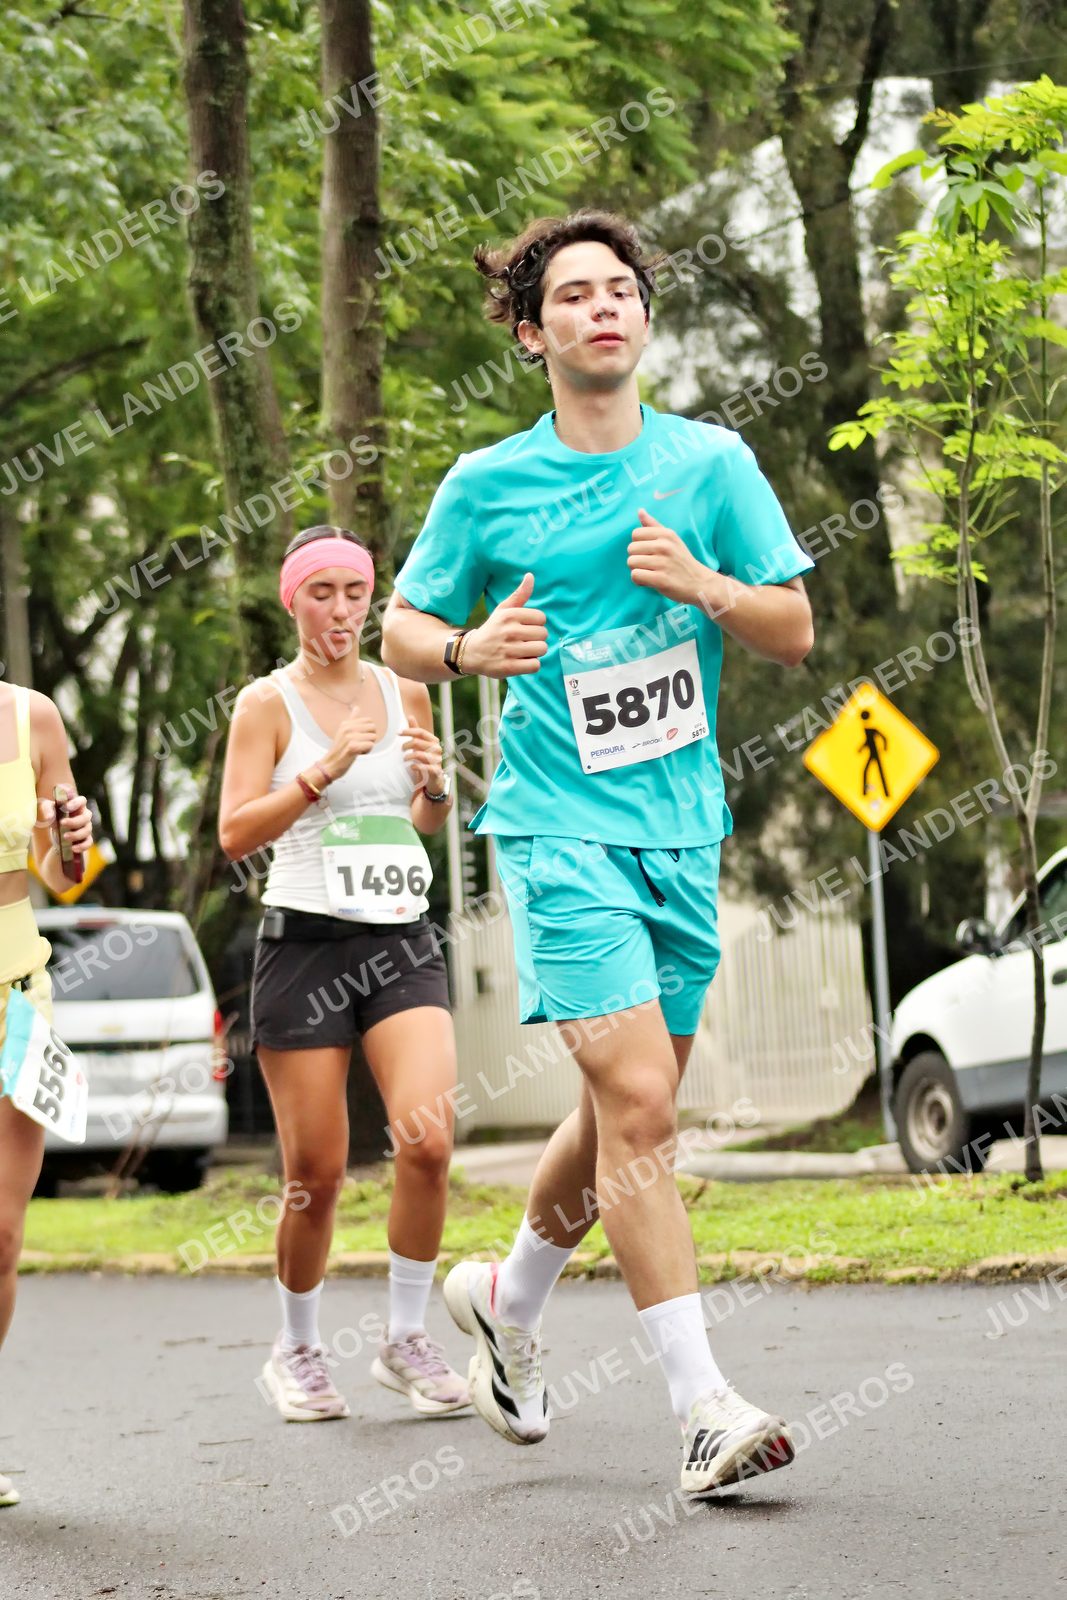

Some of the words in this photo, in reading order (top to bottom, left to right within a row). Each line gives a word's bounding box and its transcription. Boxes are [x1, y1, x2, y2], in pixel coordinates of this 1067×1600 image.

[582, 669, 695, 736] 5870
[590, 745, 625, 758] PERDURA
[337, 864, 426, 896] 1496
